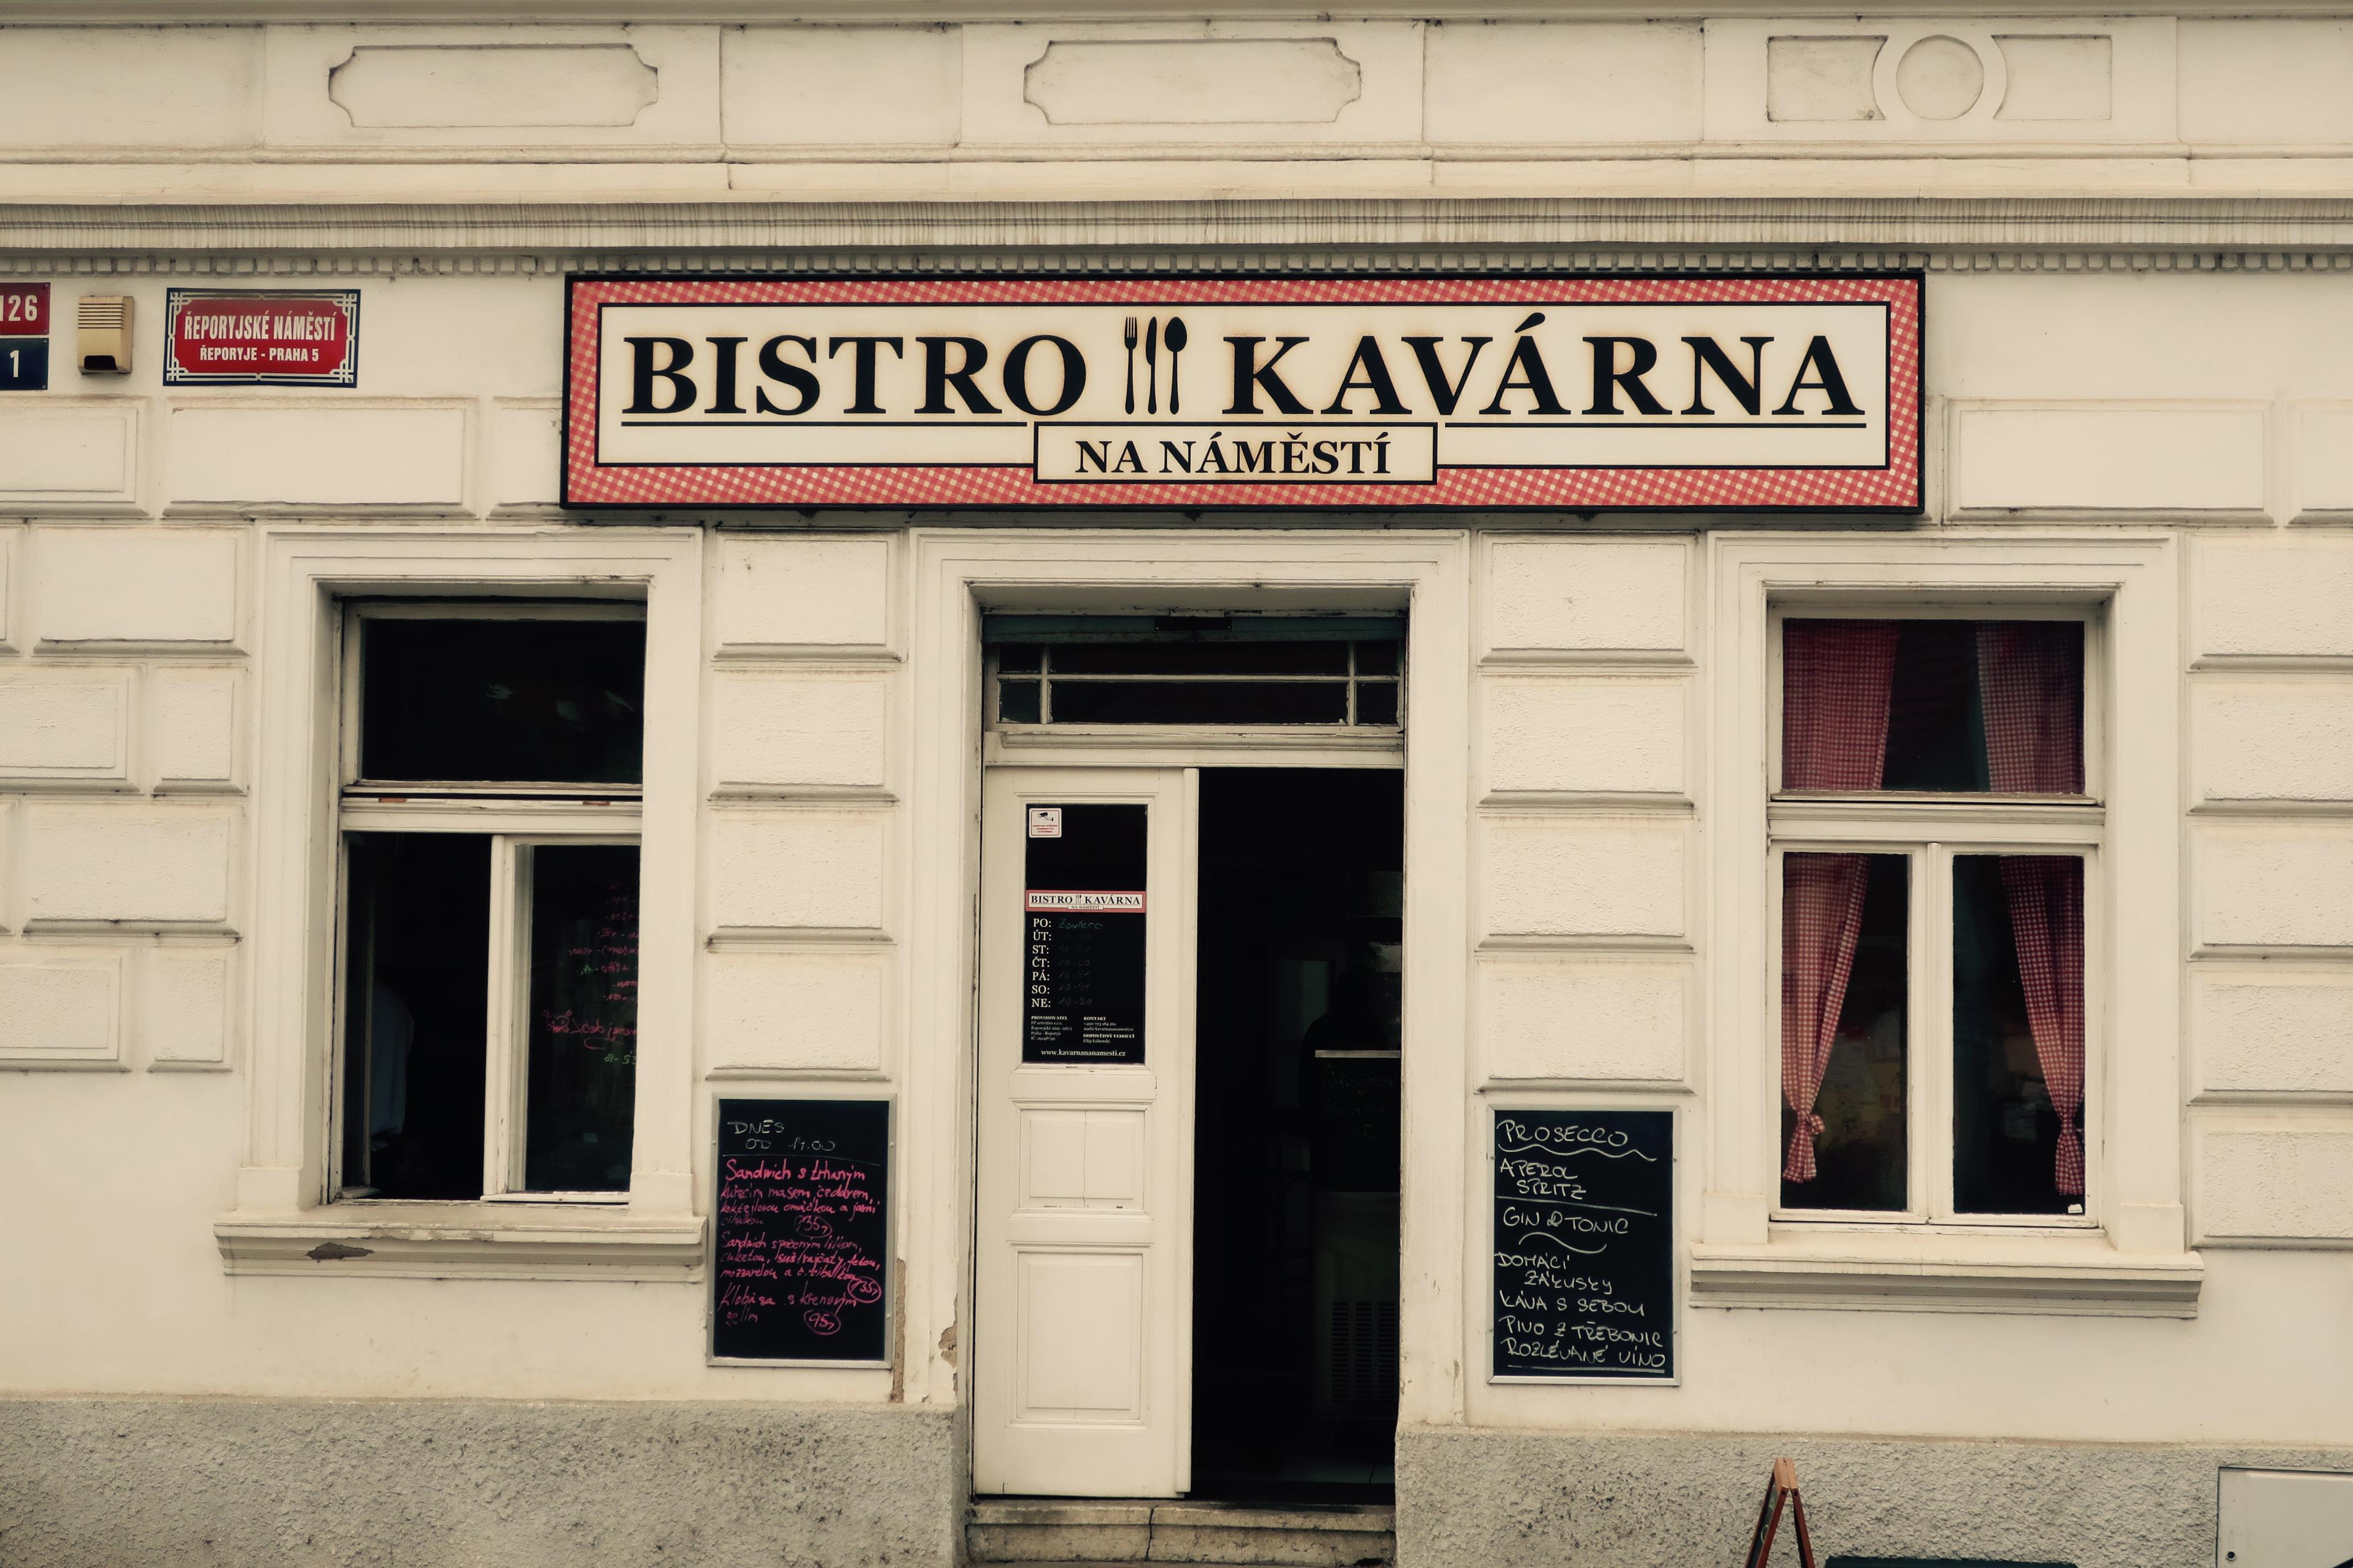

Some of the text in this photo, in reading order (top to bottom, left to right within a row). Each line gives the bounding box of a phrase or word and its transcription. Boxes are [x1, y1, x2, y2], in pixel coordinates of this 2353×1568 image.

[184, 310, 336, 341] ŘEPORYJSKÉ NÁMĚSTÍ
[200, 344, 258, 361] ŘEPORYJE
[269, 346, 308, 362] PRAHA
[312, 347, 319, 362] 5
[10, 350, 19, 378] 1
[622, 312, 1865, 417] BISTRO KAVÁRNA
[1075, 431, 1391, 475] NA NÁMĚSTÍ
[1031, 895, 1140, 905] BISTRO KAVÁRNA
[1033, 918, 1051, 928] PO:
[1033, 929, 1051, 941] ÚT:
[1032, 945, 1049, 954] ST:
[1032, 956, 1050, 968] ČT:
[1032, 969, 1050, 981] PÁ:
[1031, 985, 1050, 995] SO:
[1031, 998, 1051, 1007] NE:
[727, 1119, 785, 1134] DNES
[1497, 1119, 1628, 1147] PROSECCO
[745, 1138, 772, 1149] OD
[725, 1157, 866, 1189] Sandwich s trhaným
[1499, 1157, 1578, 1179] APEROL
[1517, 1178, 1587, 1200] SPRITZ
[1504, 1207, 1539, 1226] GIN
[1564, 1216, 1628, 1234] TONIC
[721, 1230, 766, 1249] Sandwich
[1494, 1252, 1570, 1270] DOMÁCÍ
[1524, 1270, 1612, 1295] ZÁKUSKY
[1499, 1290, 1645, 1317] KÁVA S SEBOU
[1499, 1315, 1663, 1347] PIVO Z TŘEBONIC
[1501, 1337, 1665, 1367] ROZLÉVANÉ VÍNO
